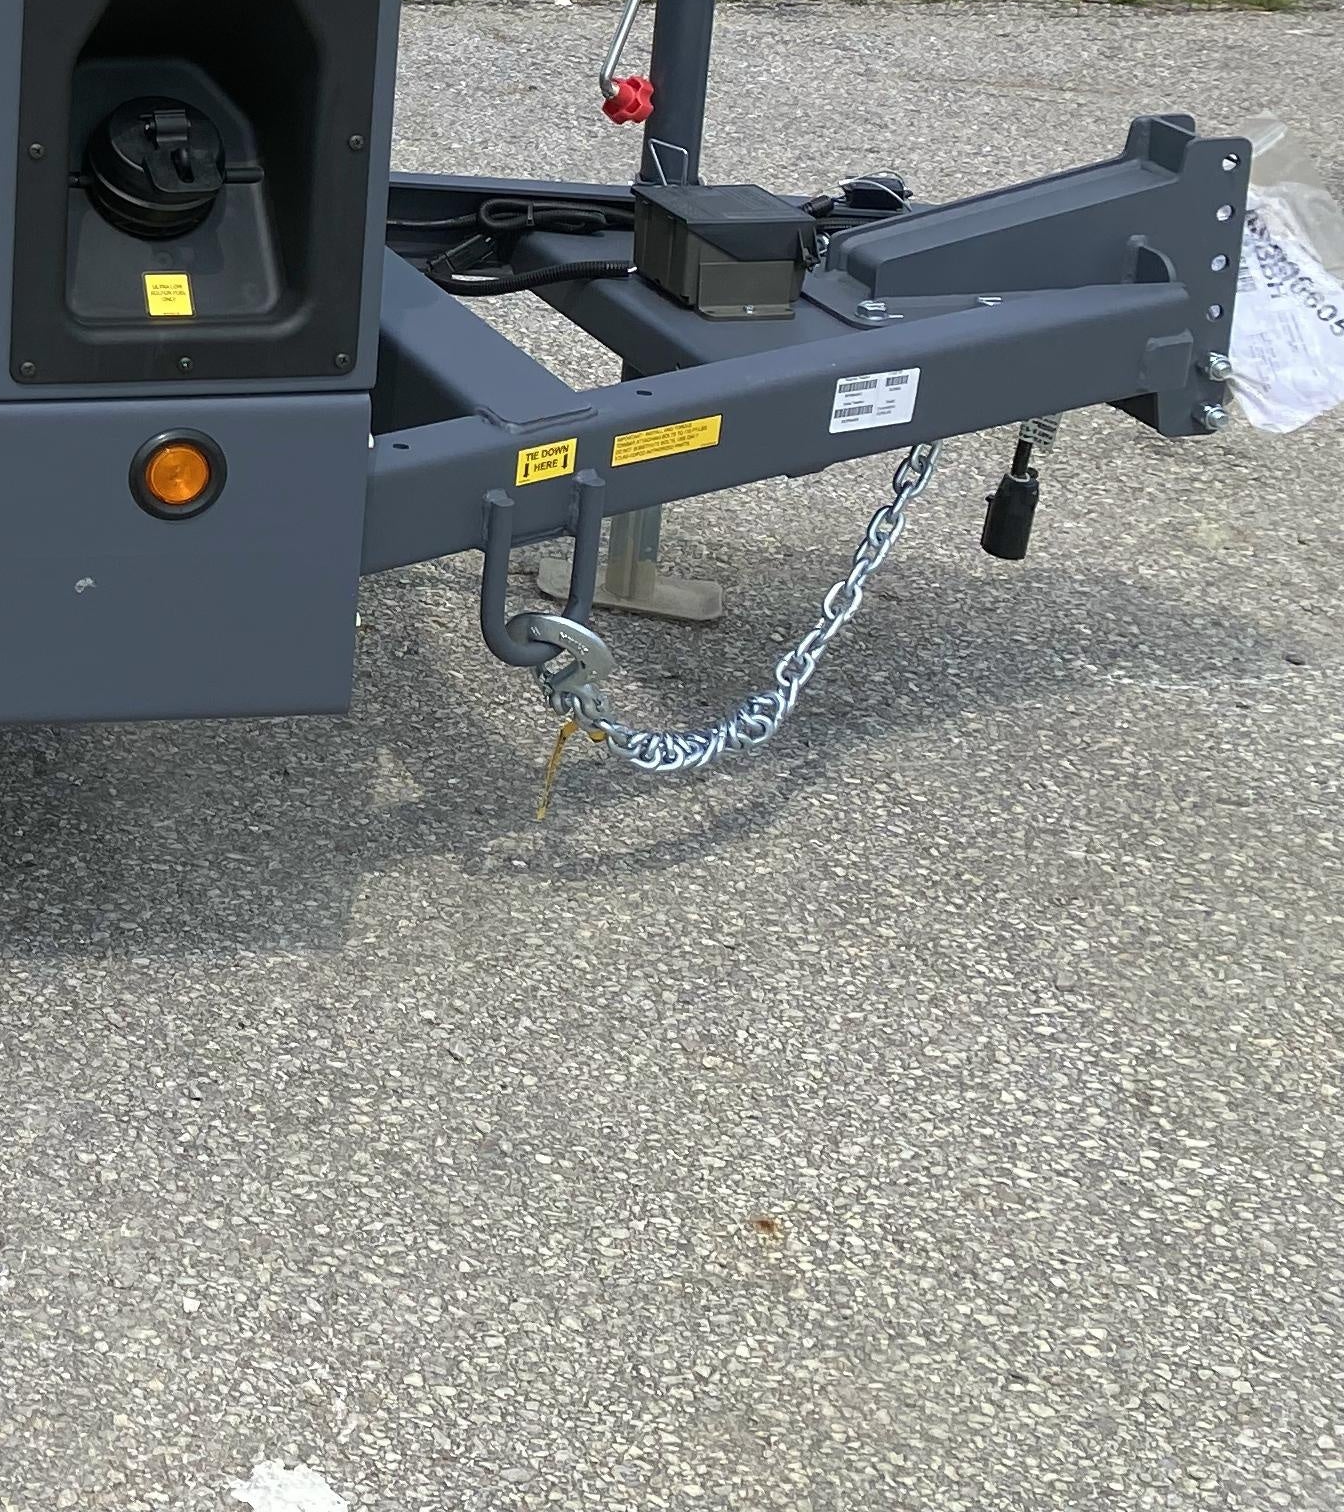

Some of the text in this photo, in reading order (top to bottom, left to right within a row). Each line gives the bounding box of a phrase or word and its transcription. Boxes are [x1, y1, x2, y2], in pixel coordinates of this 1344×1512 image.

[525, 444, 569, 462] TIE DOWN
[533, 458, 558, 472] HERE
